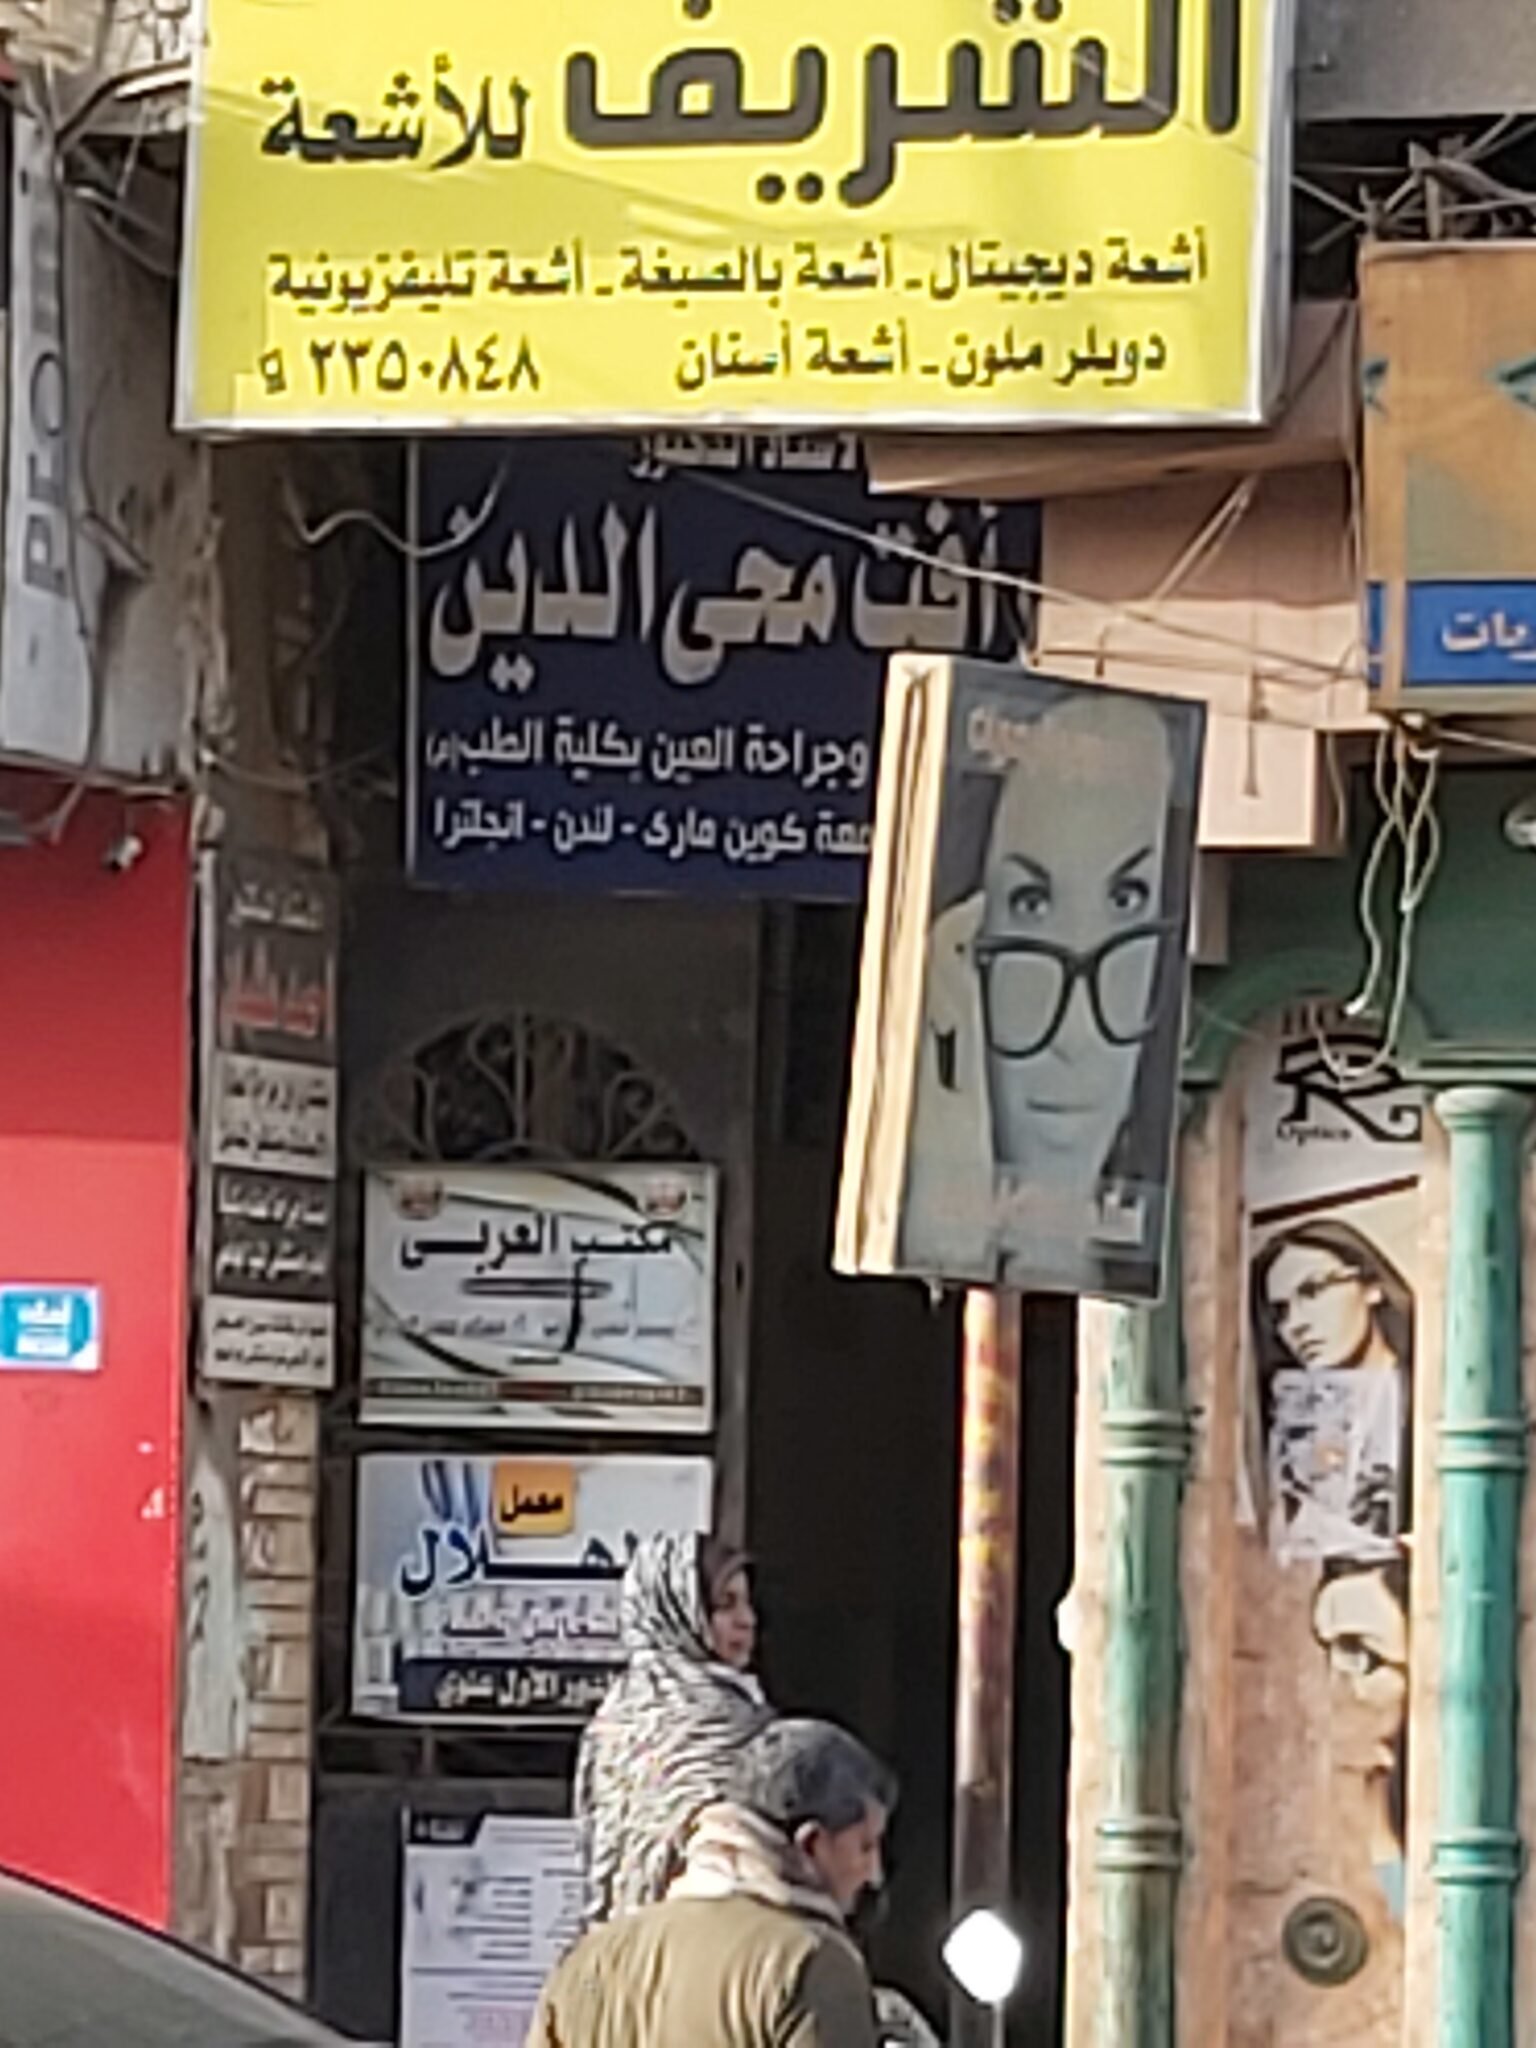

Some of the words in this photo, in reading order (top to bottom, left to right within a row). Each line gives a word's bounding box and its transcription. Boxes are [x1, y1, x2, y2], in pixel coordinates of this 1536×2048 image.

[260, 54, 530, 171] للأشعة
[563, 0, 1241, 207] الشريف
[267, 249, 477, 315] تليفزيونية
[620, 244, 783, 308] بالصبغة
[794, 233, 893, 291] أشعة
[929, 240, 1093, 303] ديجيتال
[1106, 226, 1208, 284] أشعة
[675, 320, 792, 391] أسنان
[805, 318, 908, 375] أشعة
[947, 326, 1044, 387] ملون
[429, 502, 656, 693] الدين
[459, 716, 544, 777] الطب
[554, 716, 643, 783] بكلية
[651, 725, 733, 785] العين
[743, 724, 870, 789] وجراحة
[553, 803, 614, 852] لندن
[723, 812, 808, 863] كوين
